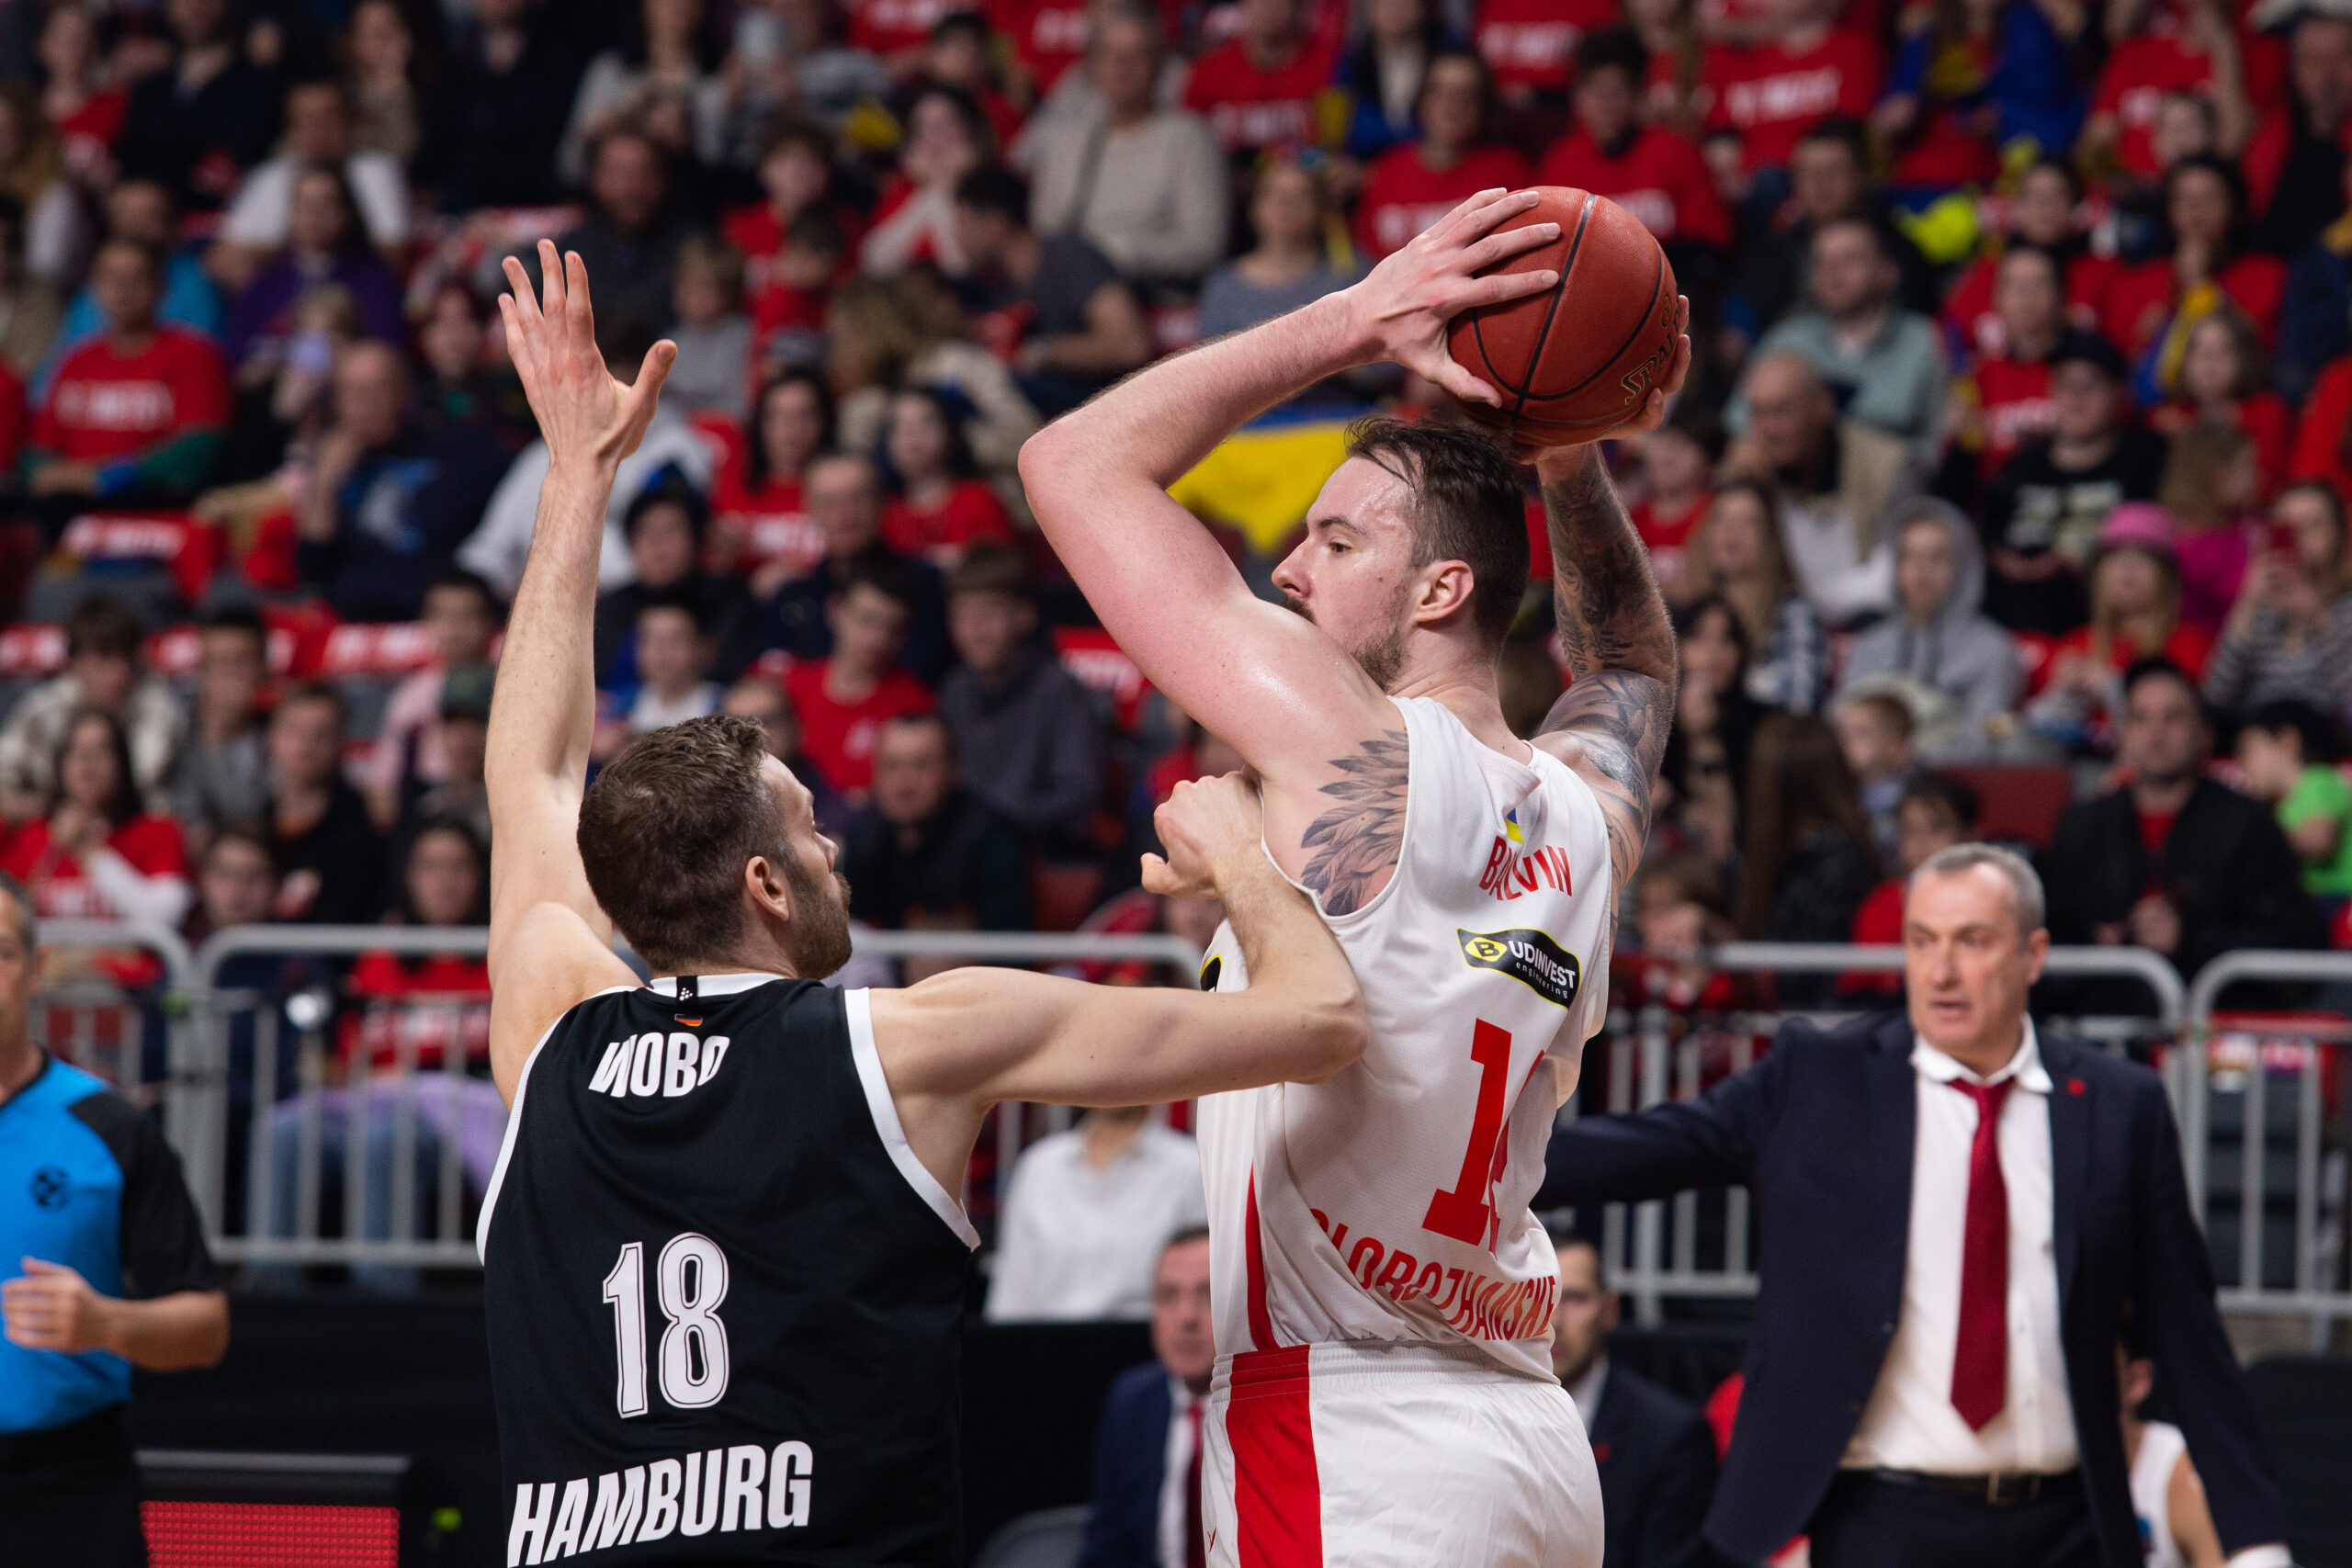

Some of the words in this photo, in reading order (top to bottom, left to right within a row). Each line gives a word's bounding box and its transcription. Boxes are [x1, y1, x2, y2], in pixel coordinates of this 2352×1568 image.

[1421, 1017, 1544, 1261] 1
[603, 1231, 729, 1419] 18
[507, 1439, 814, 1568] HAMBURG
